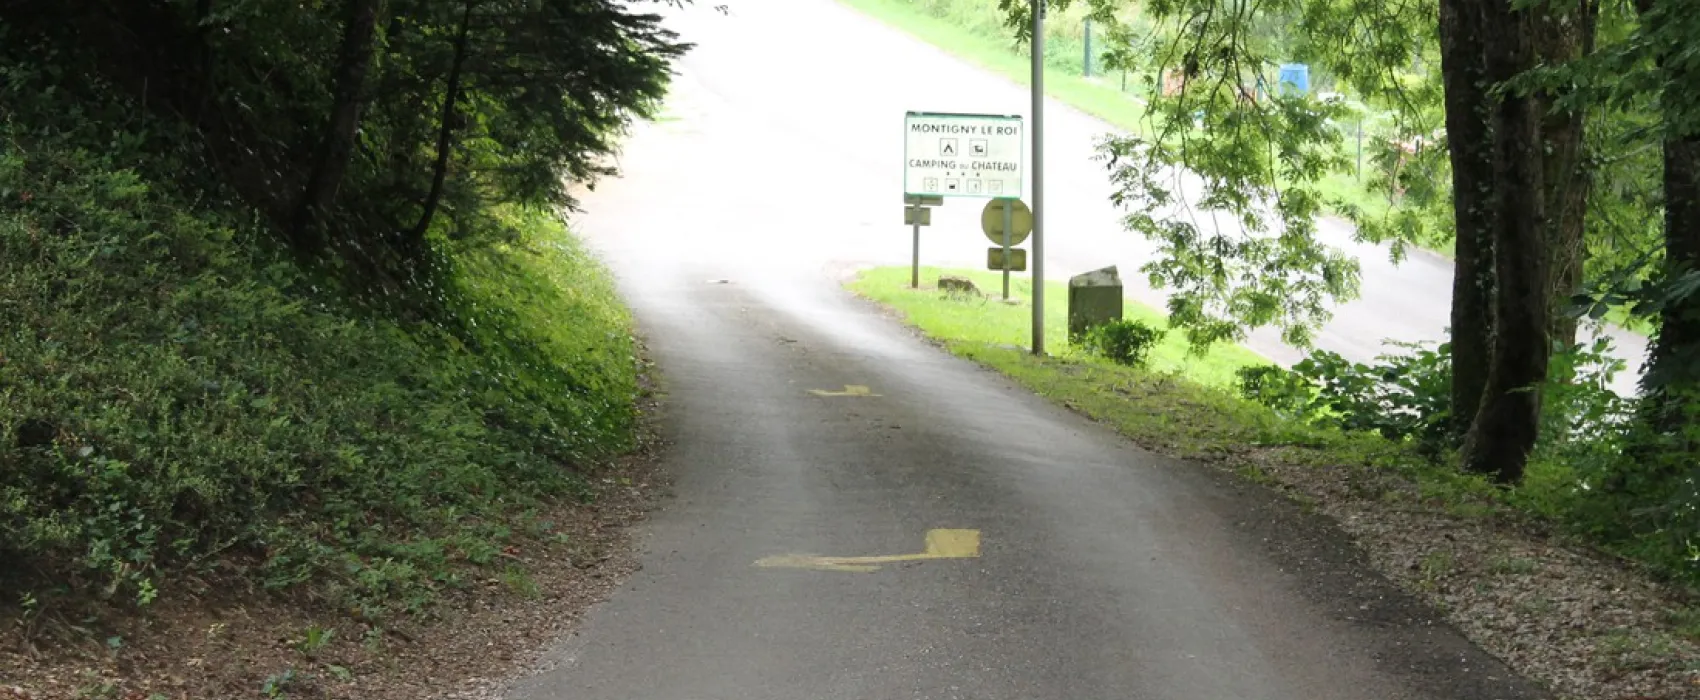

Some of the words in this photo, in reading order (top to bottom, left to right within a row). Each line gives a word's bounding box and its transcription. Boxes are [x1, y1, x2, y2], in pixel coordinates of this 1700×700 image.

[911, 123, 977, 134] MONTIGNY
[981, 126, 993, 135] LE
[996, 126, 1018, 136] ROI
[908, 159, 956, 170] CAMPING
[971, 161, 1018, 172] CHATEAU
